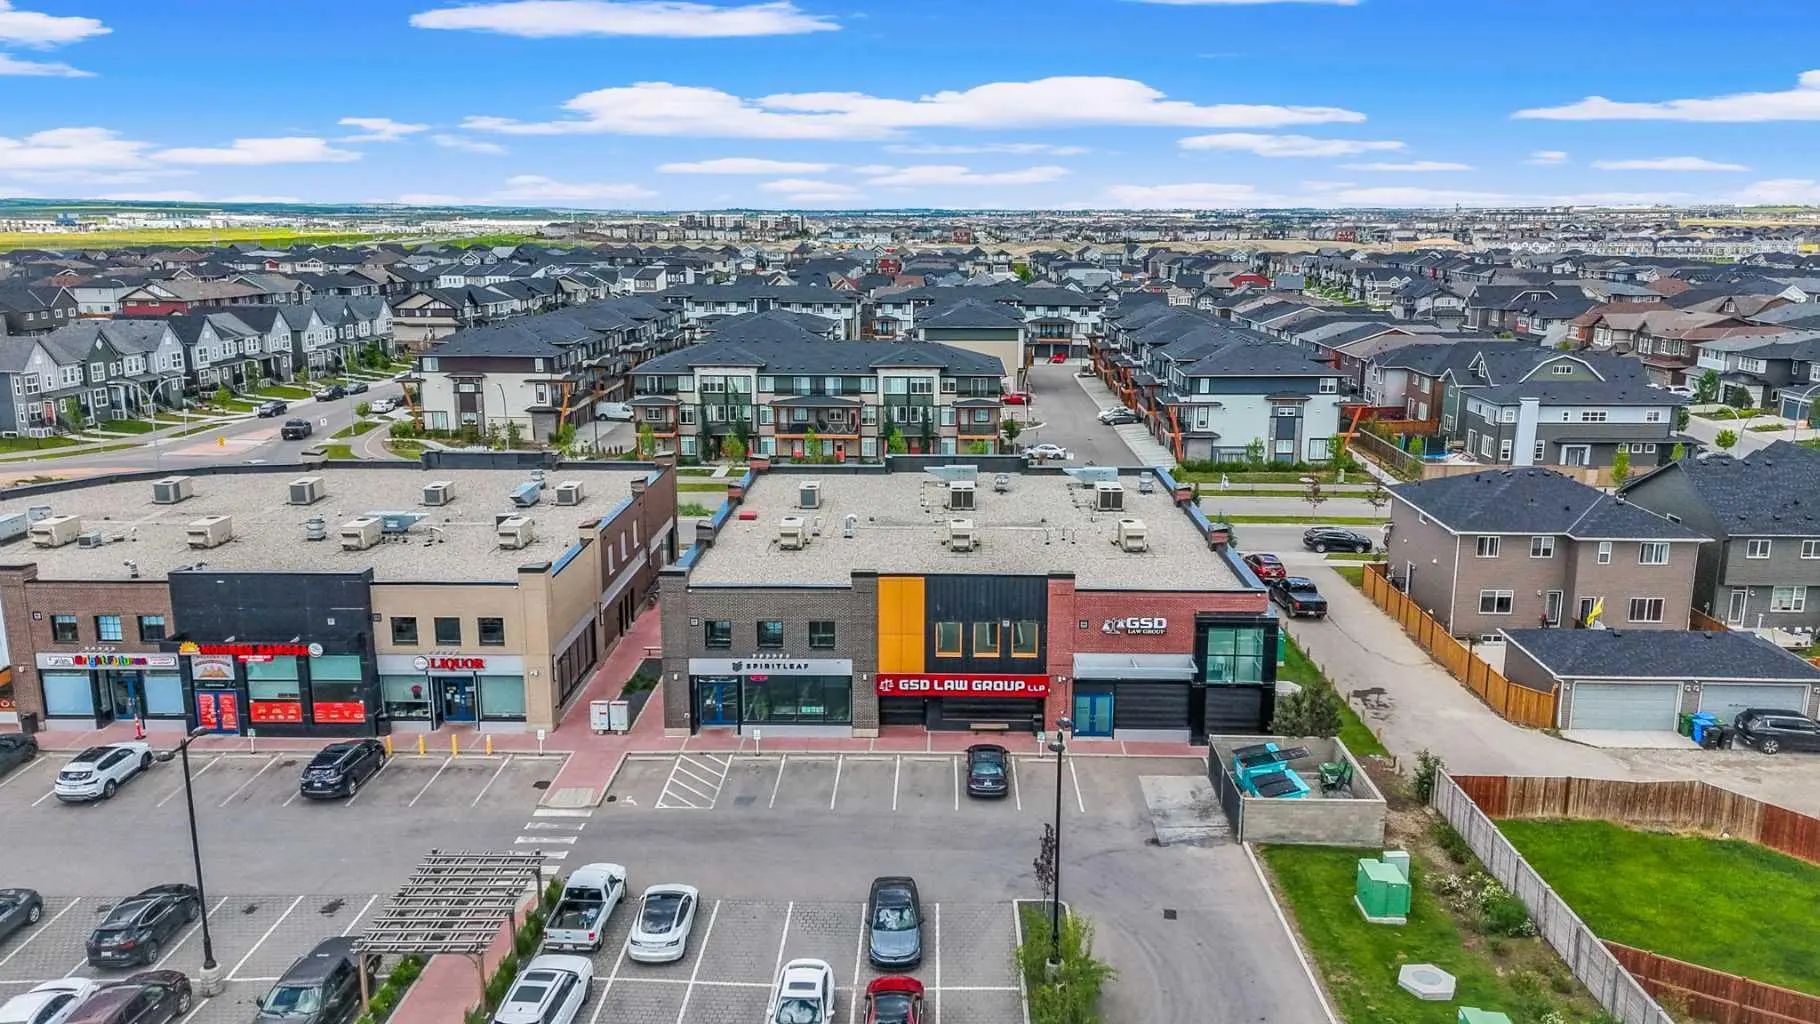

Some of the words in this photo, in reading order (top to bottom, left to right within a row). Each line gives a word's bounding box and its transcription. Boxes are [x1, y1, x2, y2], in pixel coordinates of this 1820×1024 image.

[1126, 617, 1168, 629] GSD
[429, 657, 485, 671] LIQUOR
[899, 679, 930, 690] GSD
[934, 679, 968, 690] LAW
[972, 680, 1026, 691] GROUP
